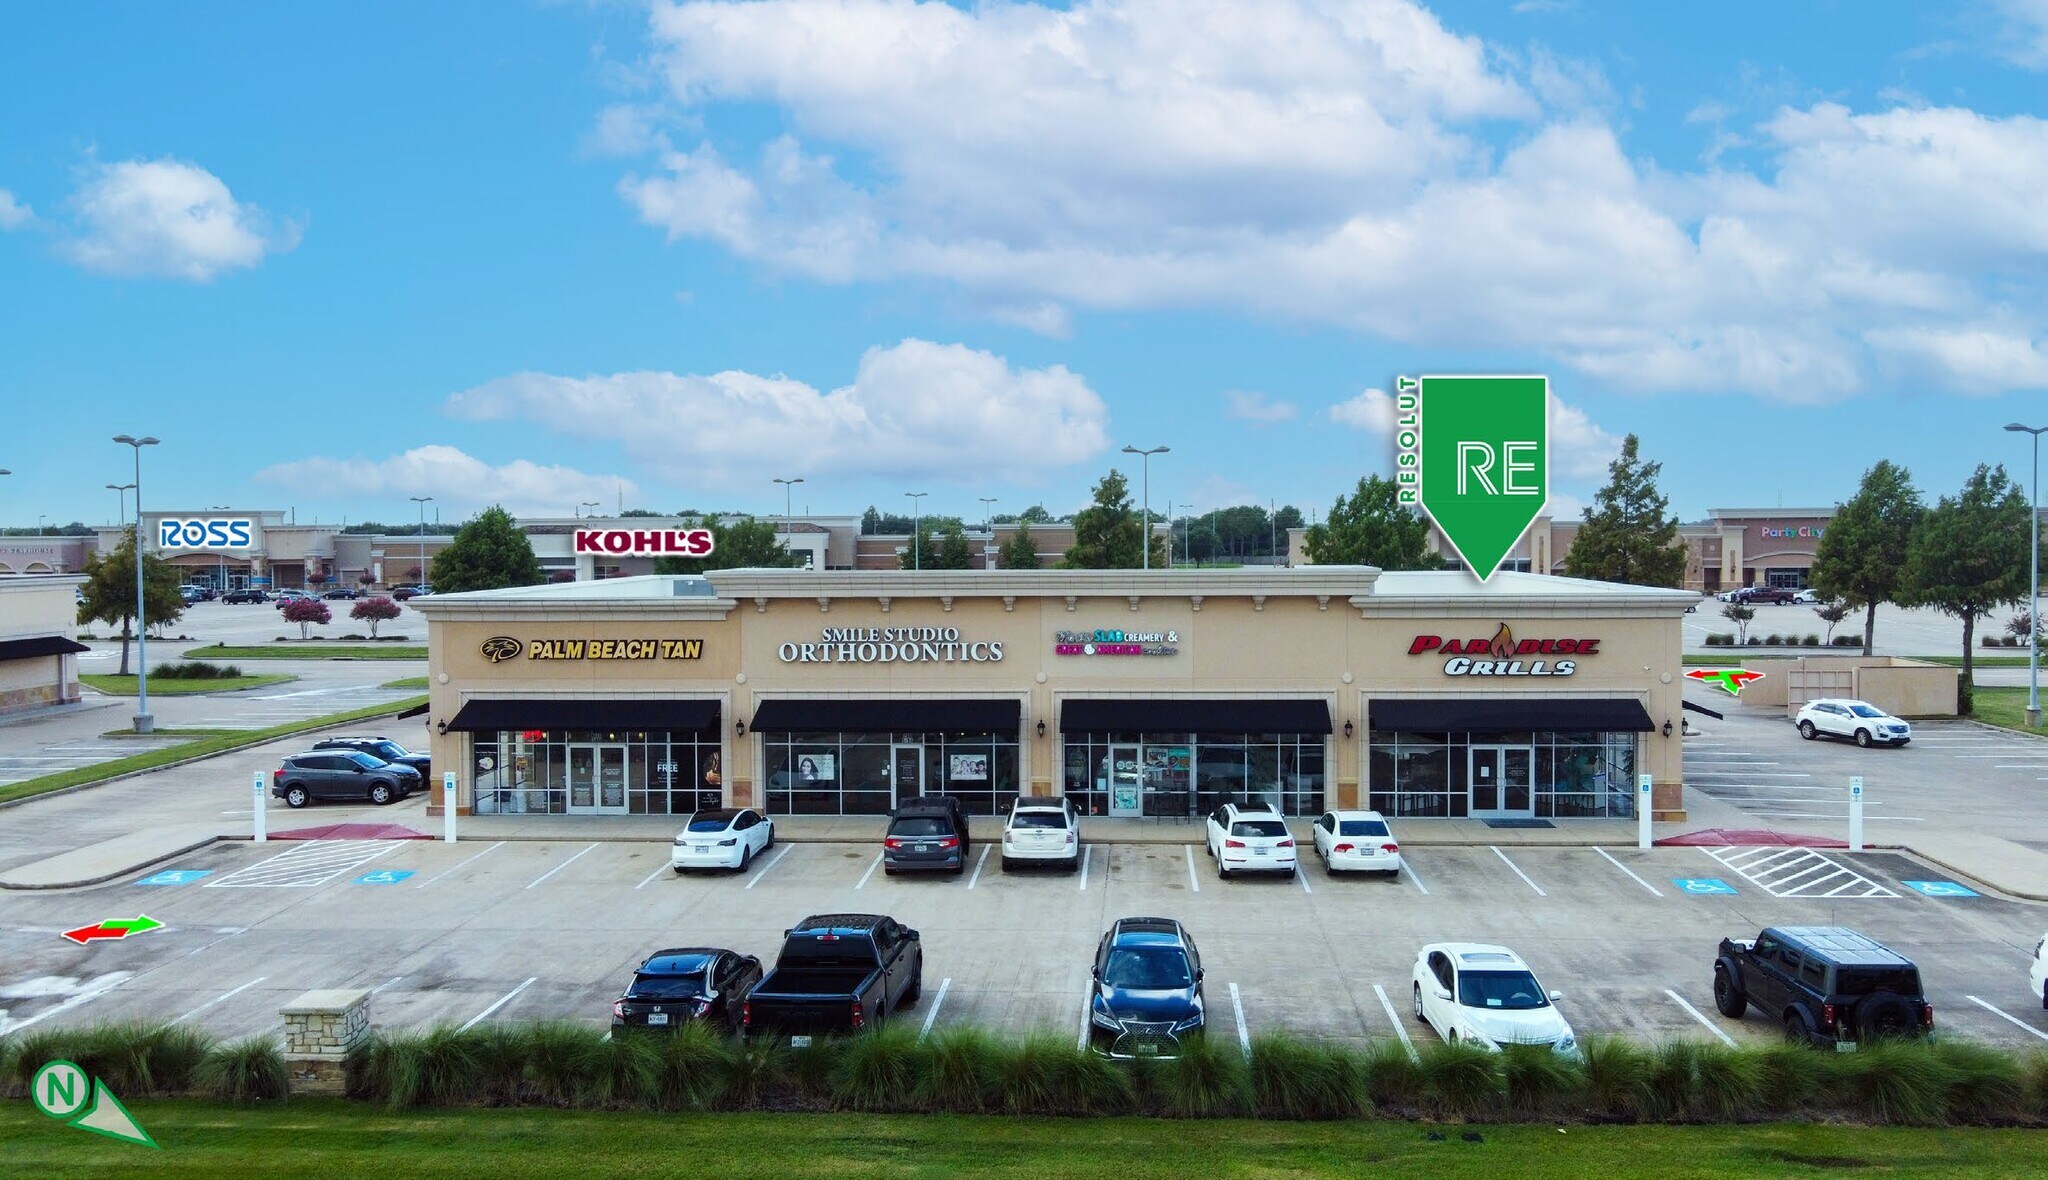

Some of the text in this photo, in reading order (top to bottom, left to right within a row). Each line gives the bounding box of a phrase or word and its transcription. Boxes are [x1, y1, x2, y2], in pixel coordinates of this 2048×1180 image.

[821, 627, 960, 642] SMILE STUDIO
[1124, 633, 1165, 643] CREAMERY
[1167, 630, 1179, 642] &
[528, 639, 704, 660] PALM BEACH TAN
[778, 641, 1004, 662] ORTHODONTICS
[1443, 657, 1577, 677] GRILLS
[657, 763, 679, 773] FREE
